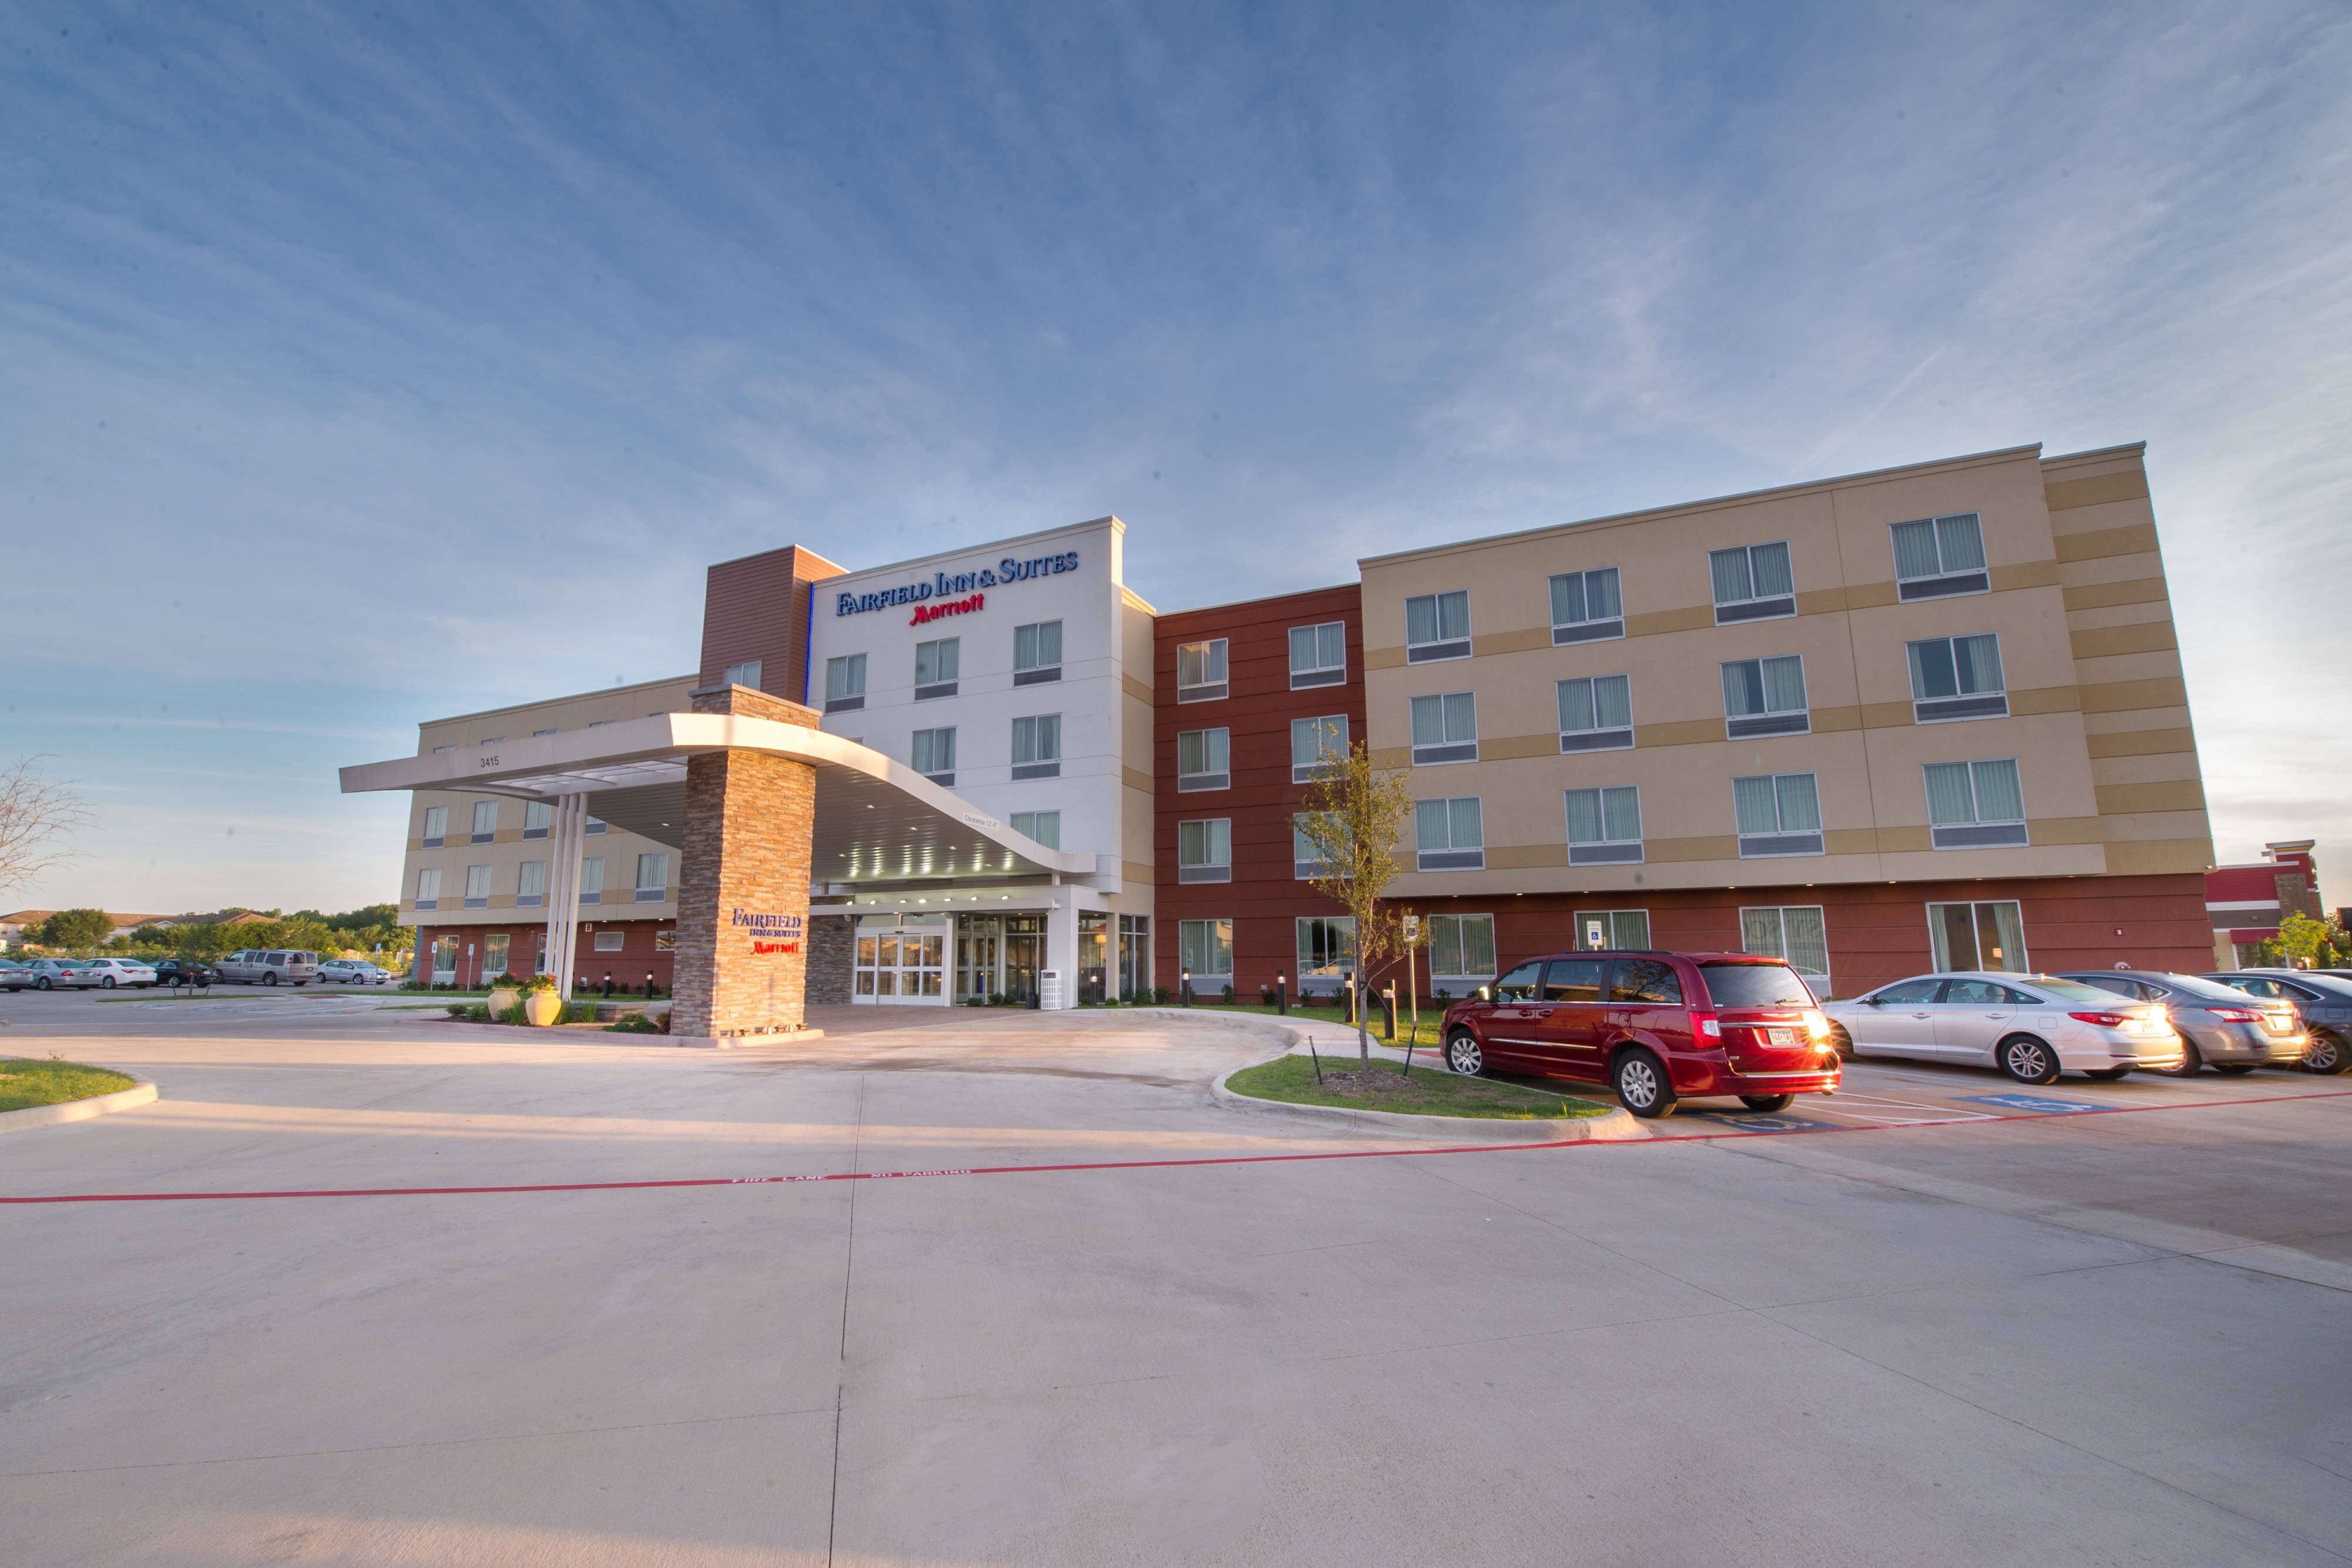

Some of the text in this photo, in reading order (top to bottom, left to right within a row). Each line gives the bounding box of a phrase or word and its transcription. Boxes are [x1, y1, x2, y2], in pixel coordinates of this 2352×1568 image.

[836, 551, 1078, 616] FAIRFIELD INN & SUITES
[909, 593, 984, 626] Marriott
[480, 756, 499, 768] 3415
[733, 908, 802, 928] FAIRFIELD
[774, 930, 801, 938] SUITES
[750, 941, 800, 955] Marriott
